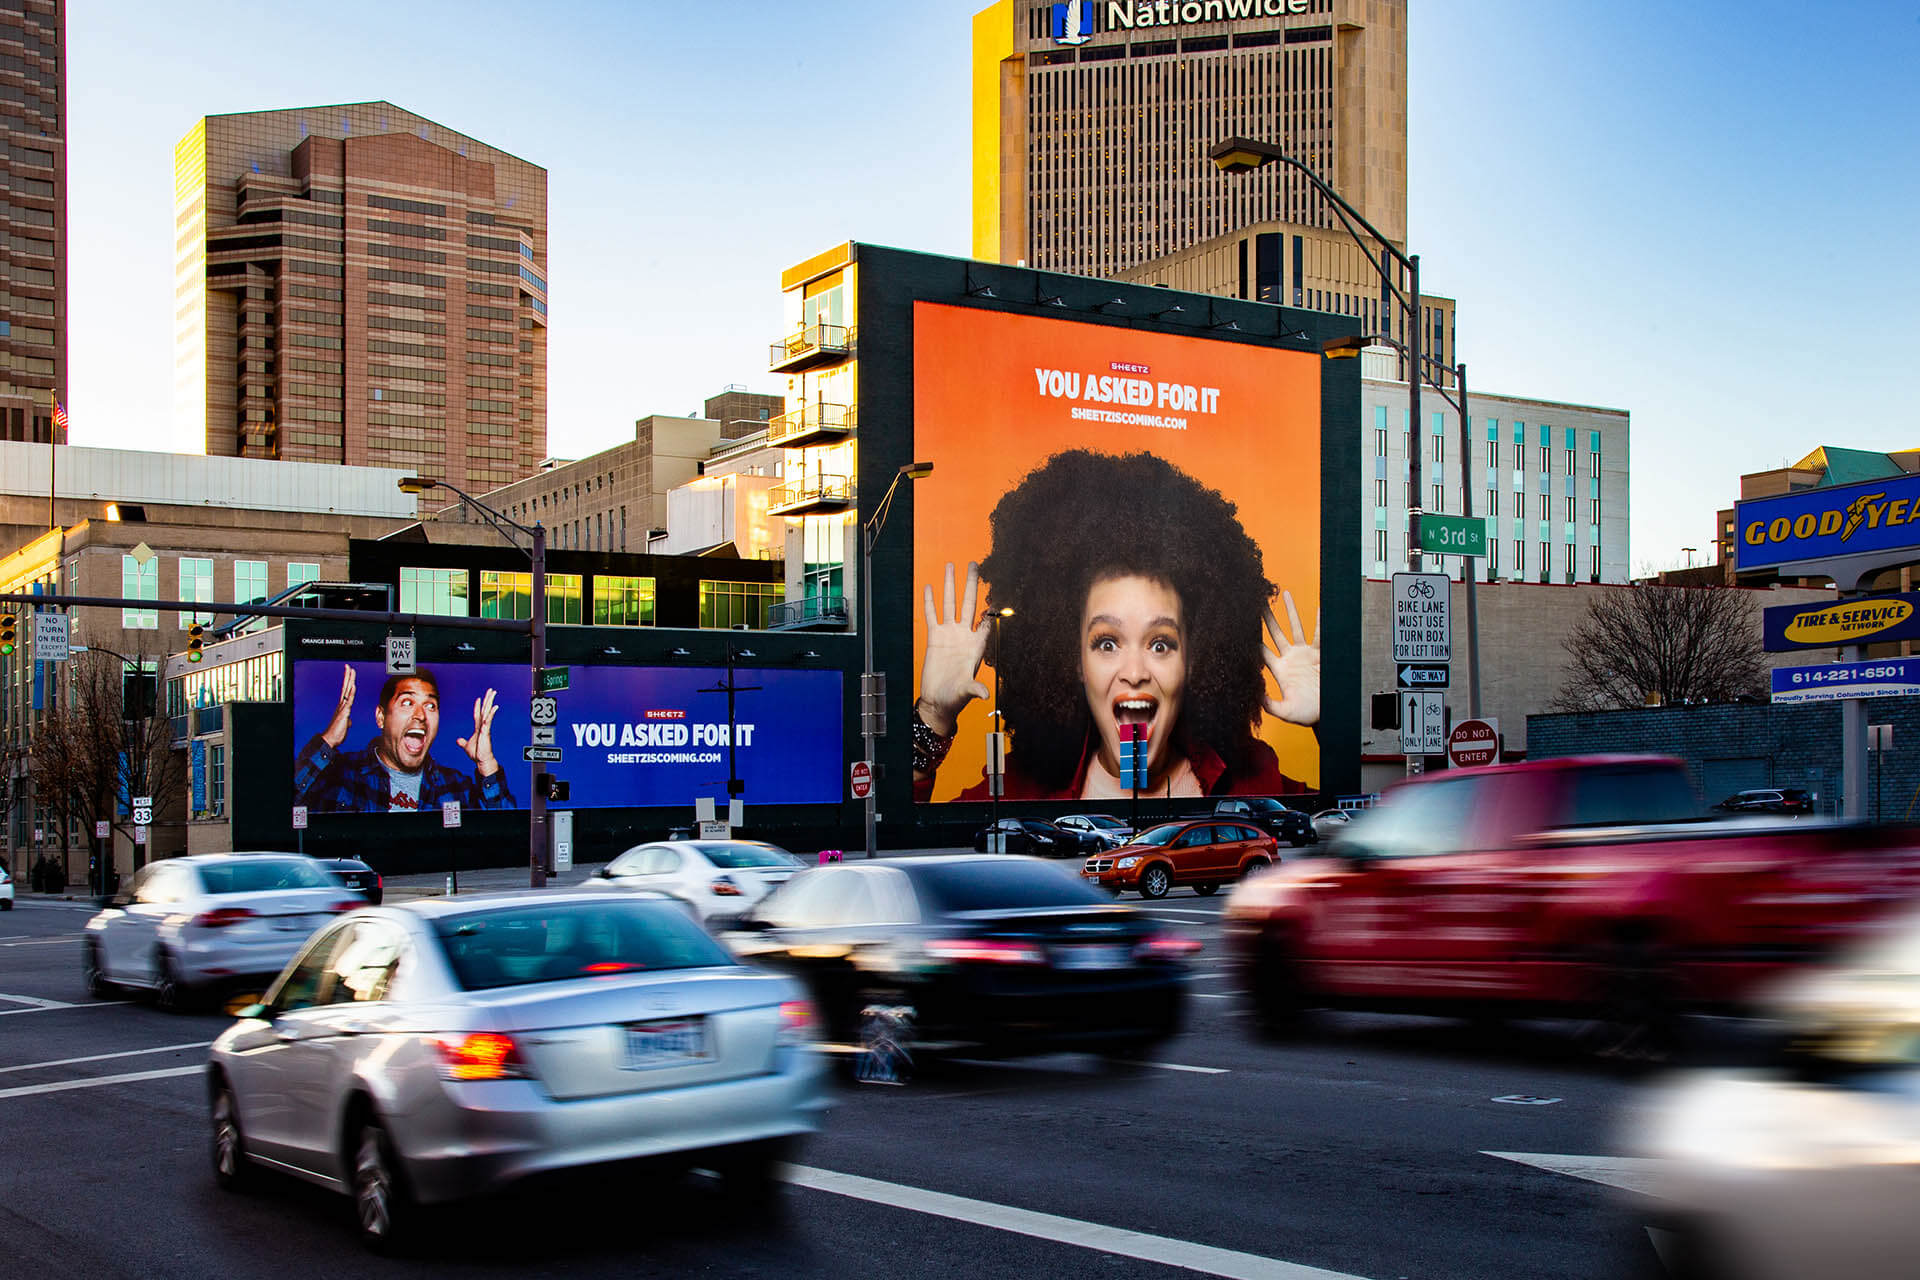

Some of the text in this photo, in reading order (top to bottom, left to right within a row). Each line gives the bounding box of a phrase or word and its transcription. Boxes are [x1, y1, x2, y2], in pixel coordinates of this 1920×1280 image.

[1111, 362, 1149, 373] SHEETZ
[1035, 368, 1220, 414] YOU ASKED FOR IT
[1071, 408, 1187, 430] SHEETZISCOMING.COM
[1428, 526, 1478, 545] N 3rd St
[1398, 601, 1445, 613] BIKE LANE
[1399, 616, 1444, 628] MUST USE
[1796, 605, 1906, 628] TIRE & SERVICE
[41, 626, 64, 634] TURN
[1840, 621, 1885, 632] NETWORK
[1400, 630, 1444, 642] TURN BOX
[391, 640, 411, 649] ONE
[391, 650, 411, 659] WAY
[1395, 645, 1449, 657] FOR LEFT TURN
[1412, 671, 1444, 681] ONE WAY
[1792, 665, 1905, 684] 614-221-6501
[1774, 694, 1803, 702] Proudly
[1805, 692, 1834, 700] Serving
[1836, 690, 1875, 698] Columbus
[534, 703, 554, 719] 23
[572, 724, 755, 747] YOU ASKED FOR IT
[1426, 725, 1441, 736] BIKE
[1456, 728, 1490, 740] DO NOT
[1405, 736, 1421, 748] ONLY
[1425, 737, 1441, 748] LANE
[607, 753, 721, 763] SHEETZISCOMING.COM
[1460, 752, 1488, 762] ENTER
[135, 811, 150, 820] 33
